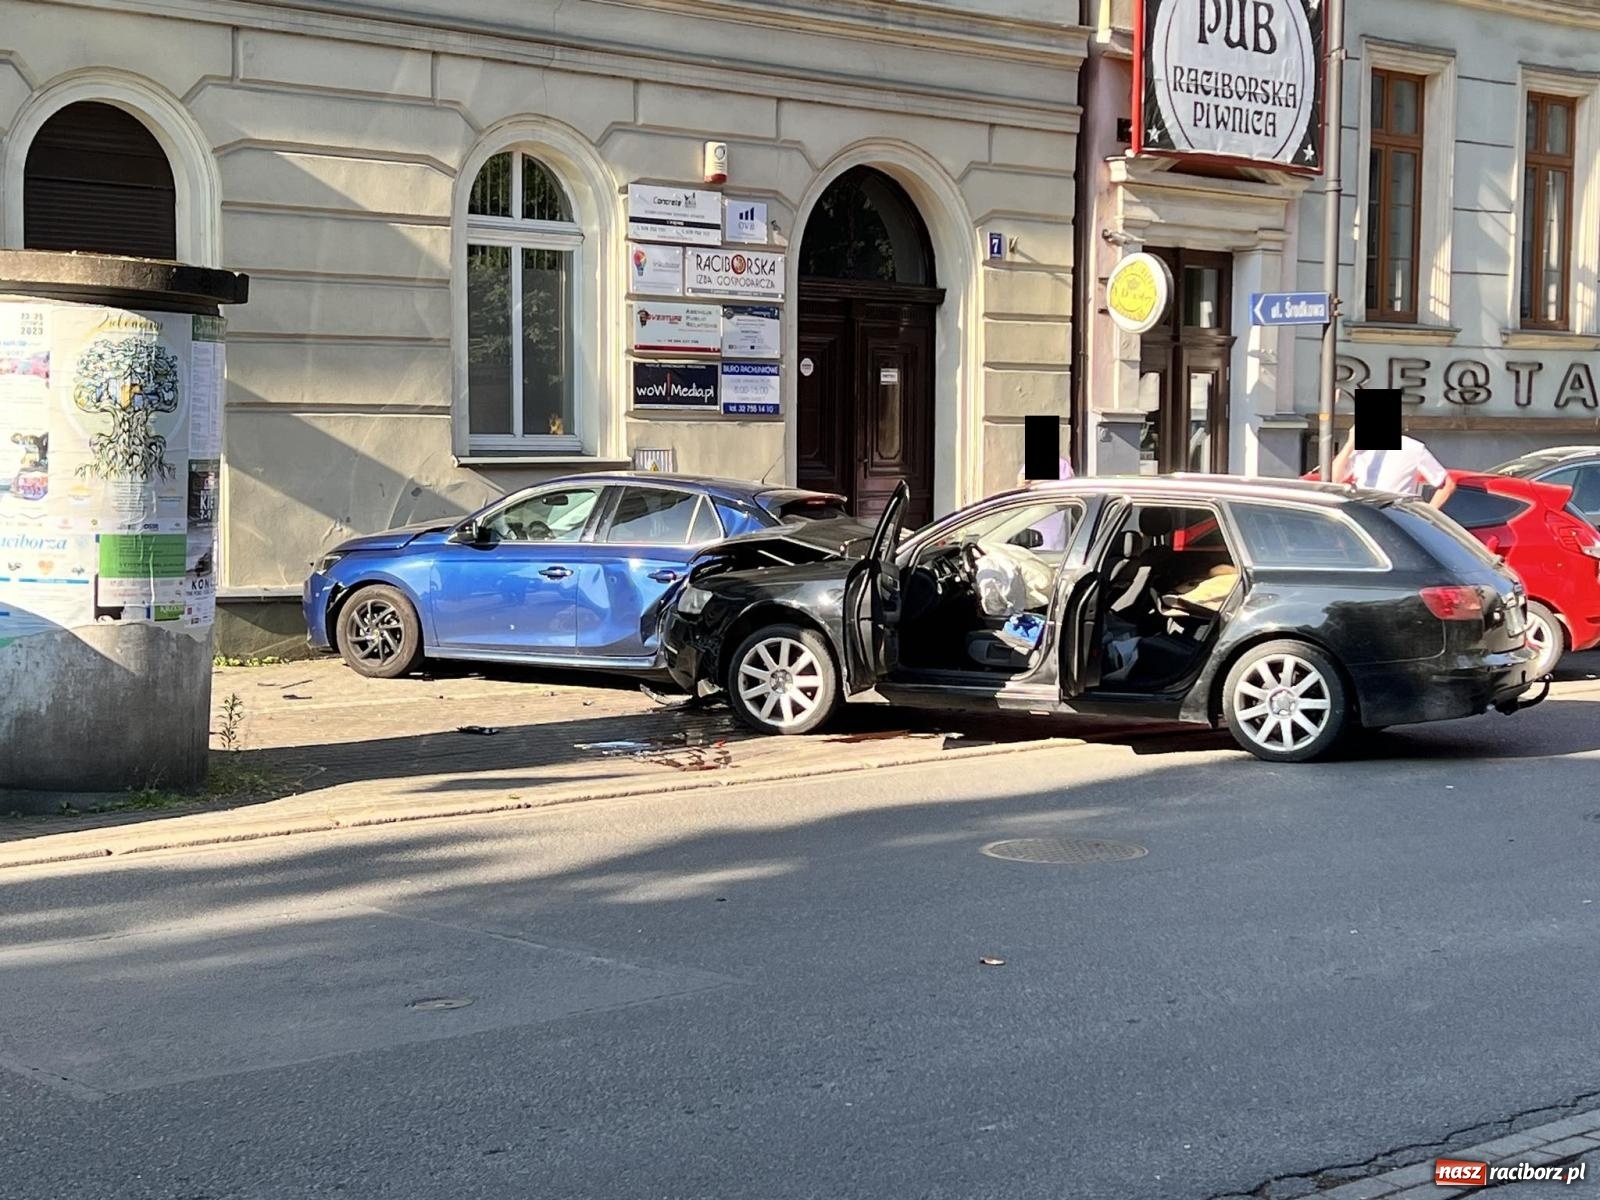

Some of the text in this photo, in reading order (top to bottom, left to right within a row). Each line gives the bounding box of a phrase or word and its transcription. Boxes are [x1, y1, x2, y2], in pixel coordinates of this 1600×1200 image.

[1197, 0, 1277, 54] PUB
[1173, 66, 1297, 109] RACIBORSKA
[1193, 101, 1276, 137] PIWNICA
[992, 238, 999, 253] 7
[696, 254, 776, 275] RACIBORSKA
[696, 274, 776, 289] IZBA GOSPODARCZA
